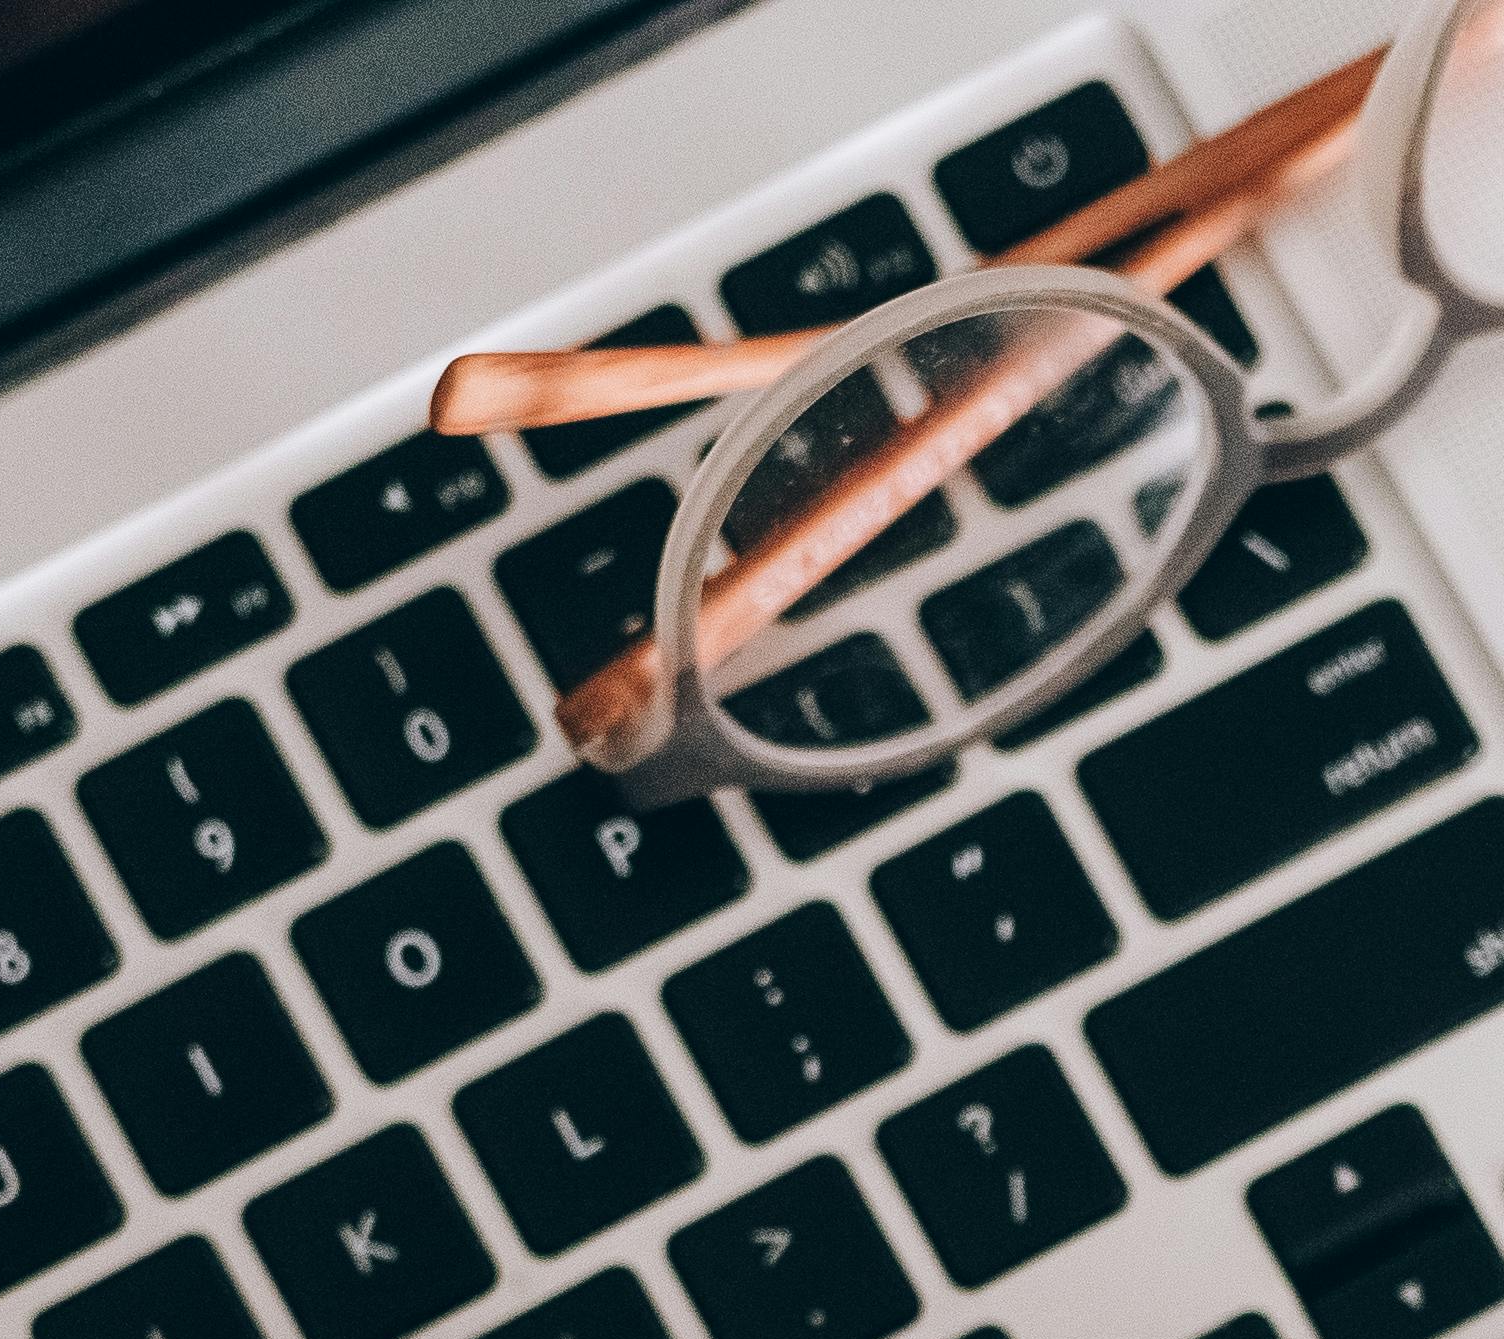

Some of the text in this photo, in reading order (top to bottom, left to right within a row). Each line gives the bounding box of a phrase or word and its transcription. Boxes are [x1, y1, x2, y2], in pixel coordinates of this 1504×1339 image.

[404, 709, 450, 762] 0
[1324, 716, 1438, 797] return
[195, 820, 235, 870] 9
[597, 819, 640, 876] P
[386, 929, 442, 988] O
[188, 1045, 222, 1095] I
[552, 1110, 604, 1160] L
[958, 1104, 999, 1155] ?
[340, 1213, 395, 1271] K
